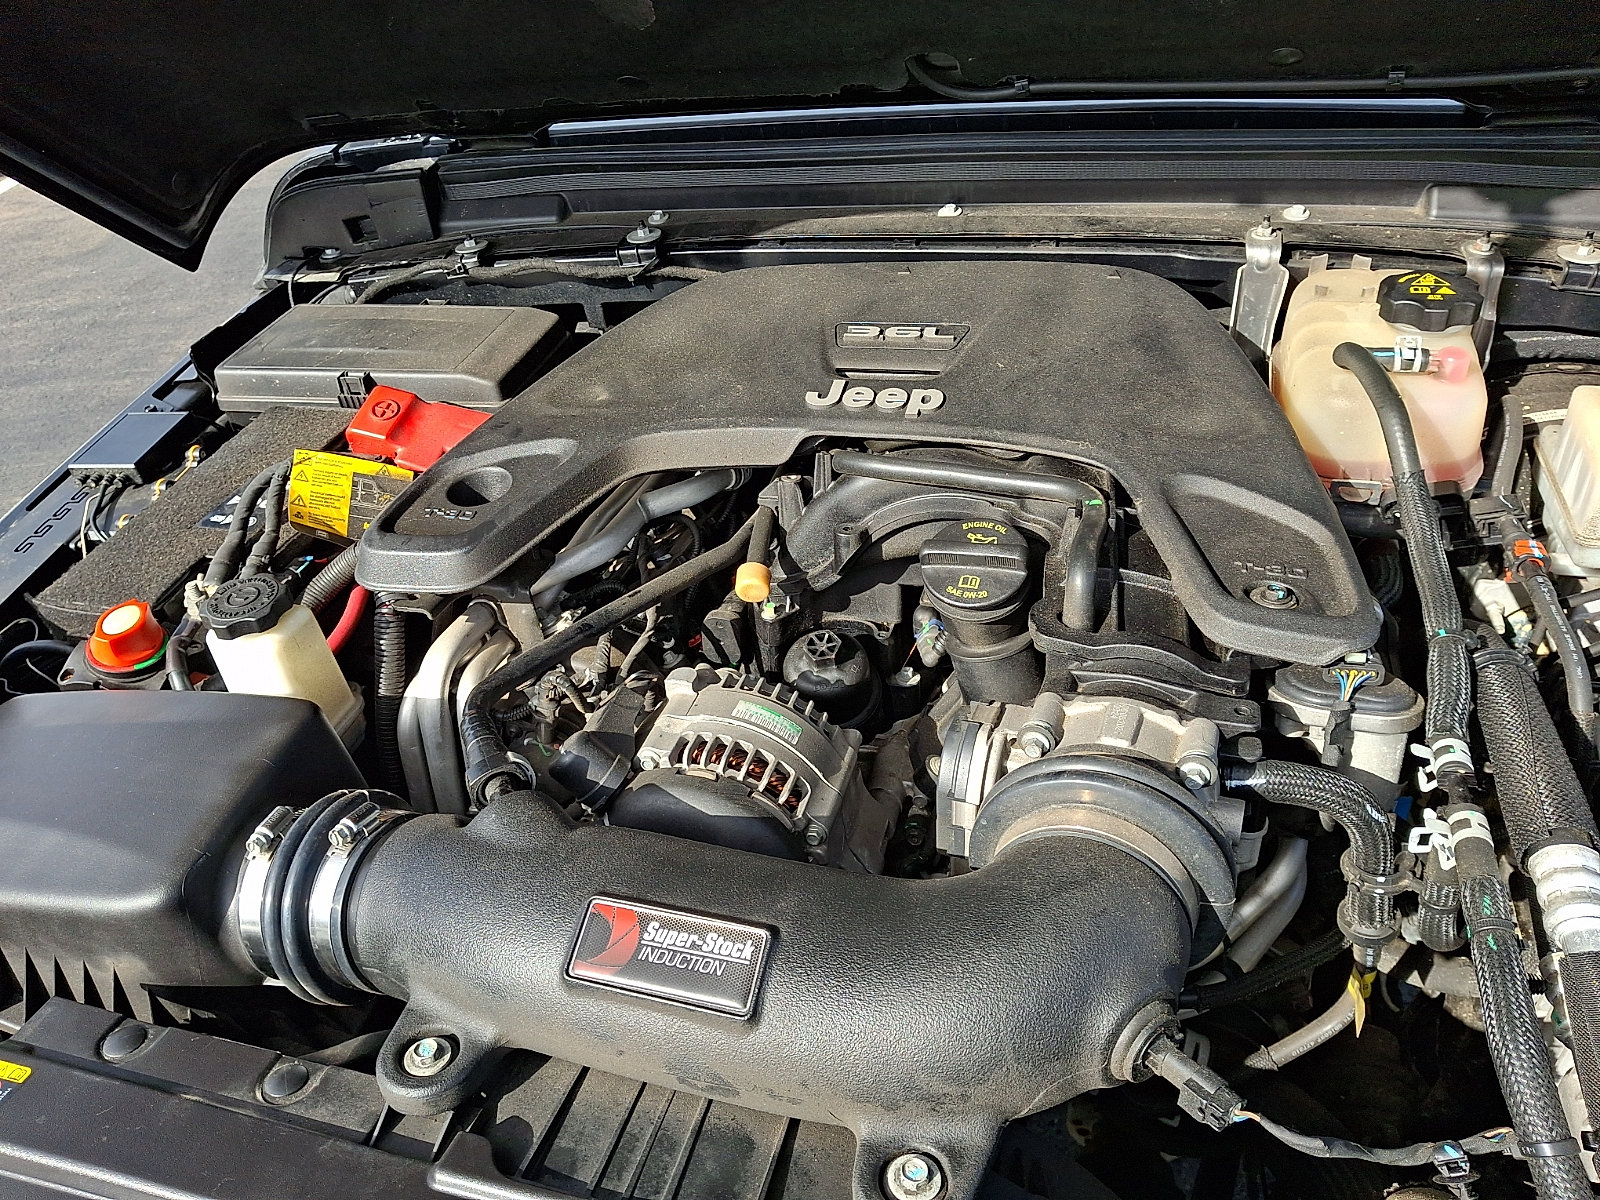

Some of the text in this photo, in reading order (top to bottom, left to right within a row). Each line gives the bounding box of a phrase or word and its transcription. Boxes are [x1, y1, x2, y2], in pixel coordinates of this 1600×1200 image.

[843, 325, 956, 343] 3.6L
[805, 379, 945, 417] Jeep
[962, 521, 1008, 535] ENGINE OIL
[946, 586, 988, 599] SAE 0W-20
[640, 921, 756, 961] Super-Stock
[637, 946, 727, 977] INDUCTION
